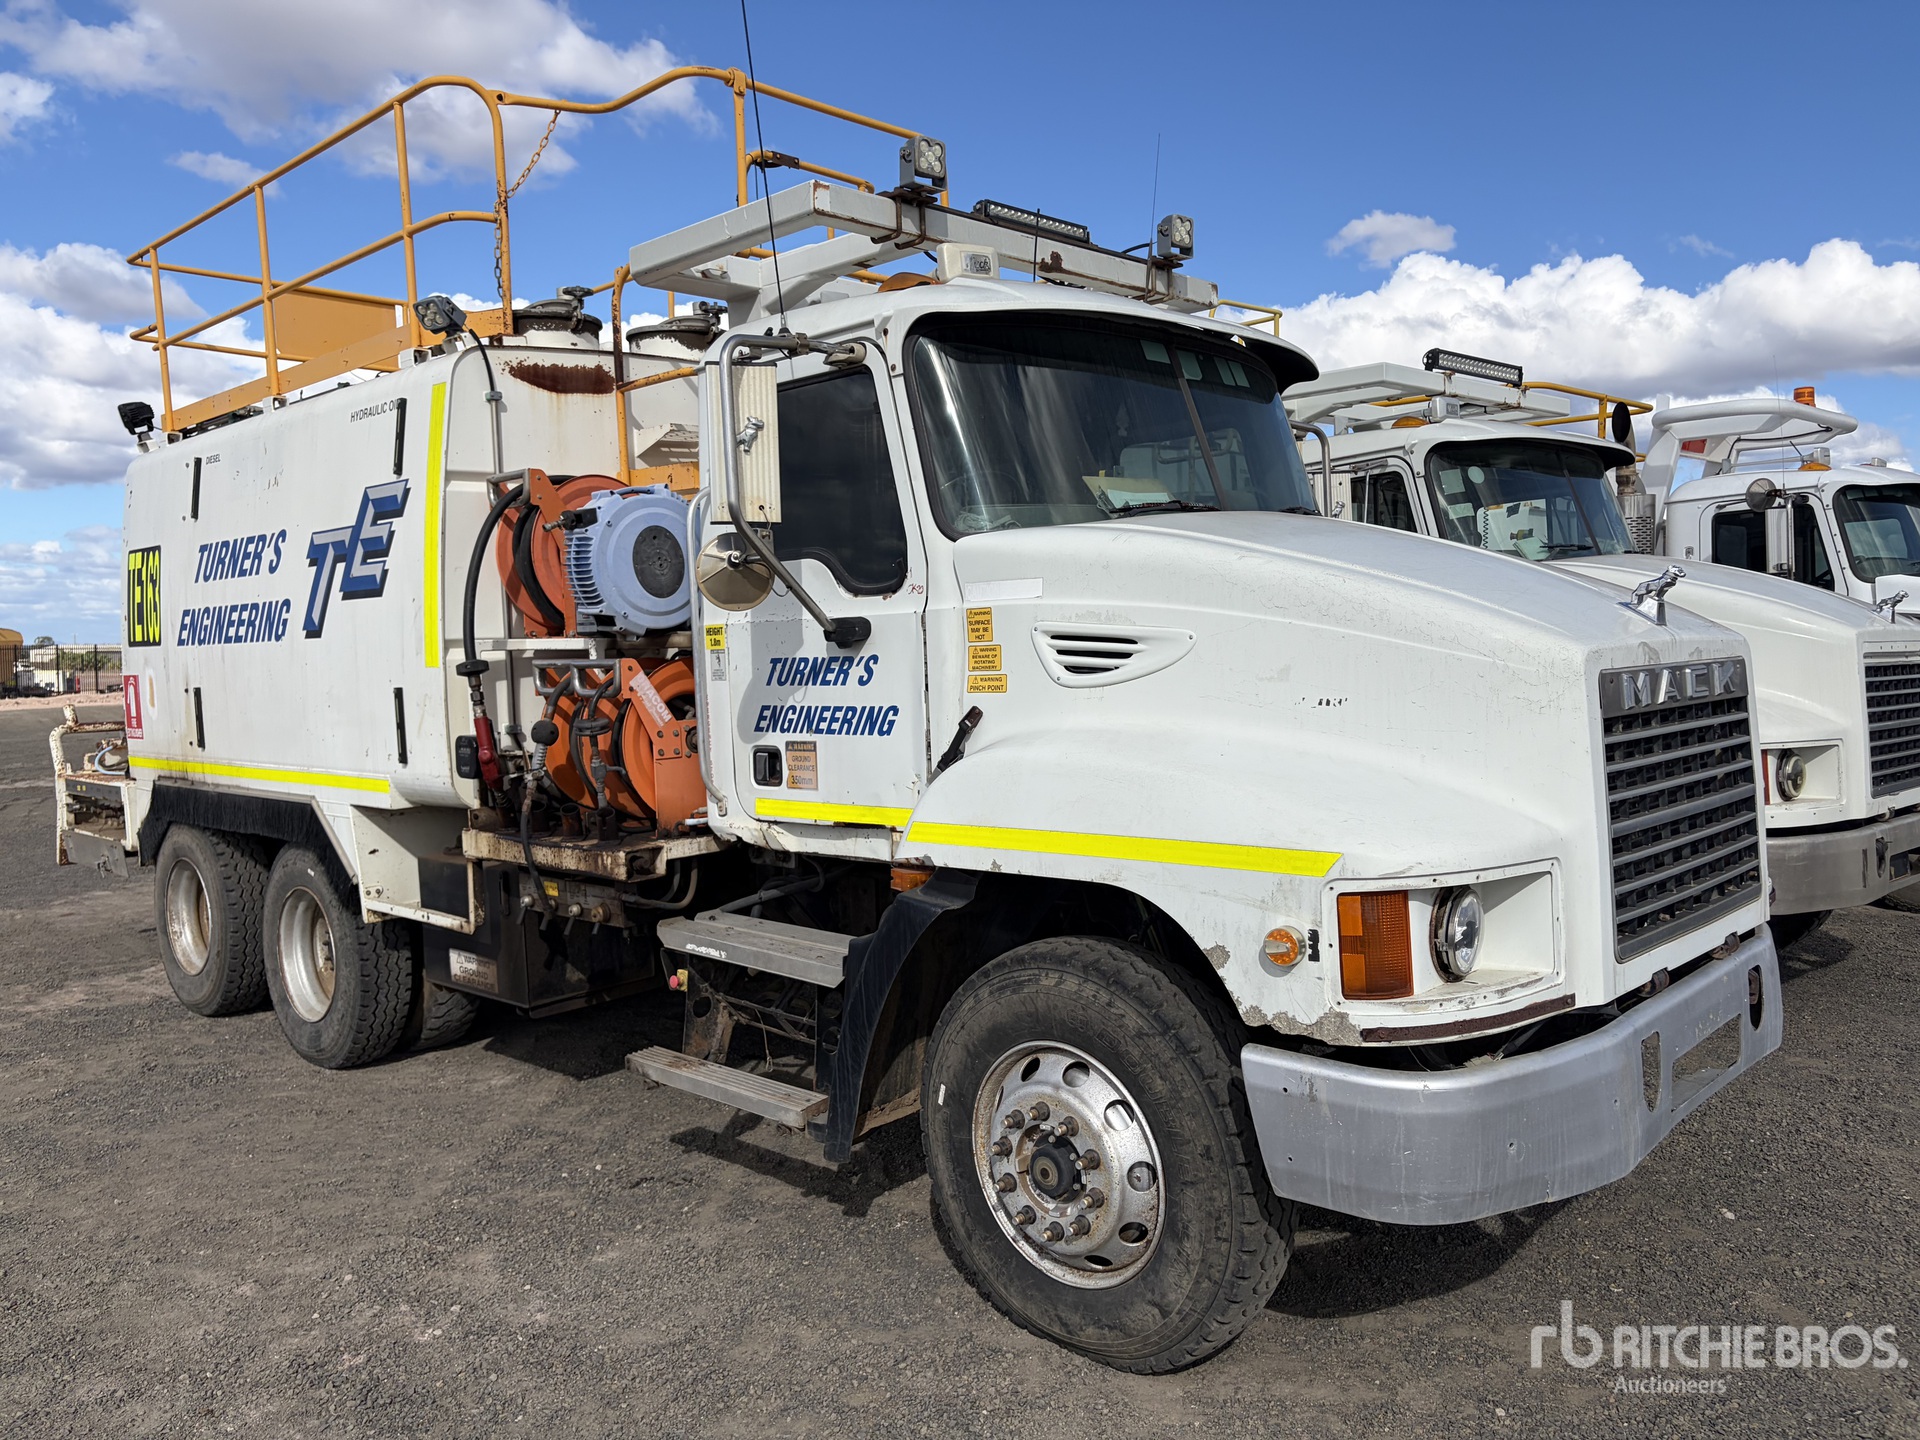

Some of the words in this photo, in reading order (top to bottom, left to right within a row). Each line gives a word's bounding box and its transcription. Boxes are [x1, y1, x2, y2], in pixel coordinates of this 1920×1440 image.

[350, 402, 387, 423] HYDRAULIC
[206, 454, 221, 465] DIESEL
[195, 529, 287, 584] TURNER'S
[128, 550, 160, 644] TE163
[177, 598, 291, 646] ENGINEERING
[705, 626, 723, 636] HEIGHT
[765, 654, 879, 687] TURNER'S
[1620, 661, 1735, 710] MACK
[753, 705, 899, 737] ENGINEERING
[788, 764, 815, 772] CLEARANCE
[791, 755, 812, 763] GROUND
[791, 774, 813, 785] 350mm
[463, 954, 491, 968] WARNING
[458, 965, 489, 980] GROUND
[453, 973, 496, 991] CLEARANCE
